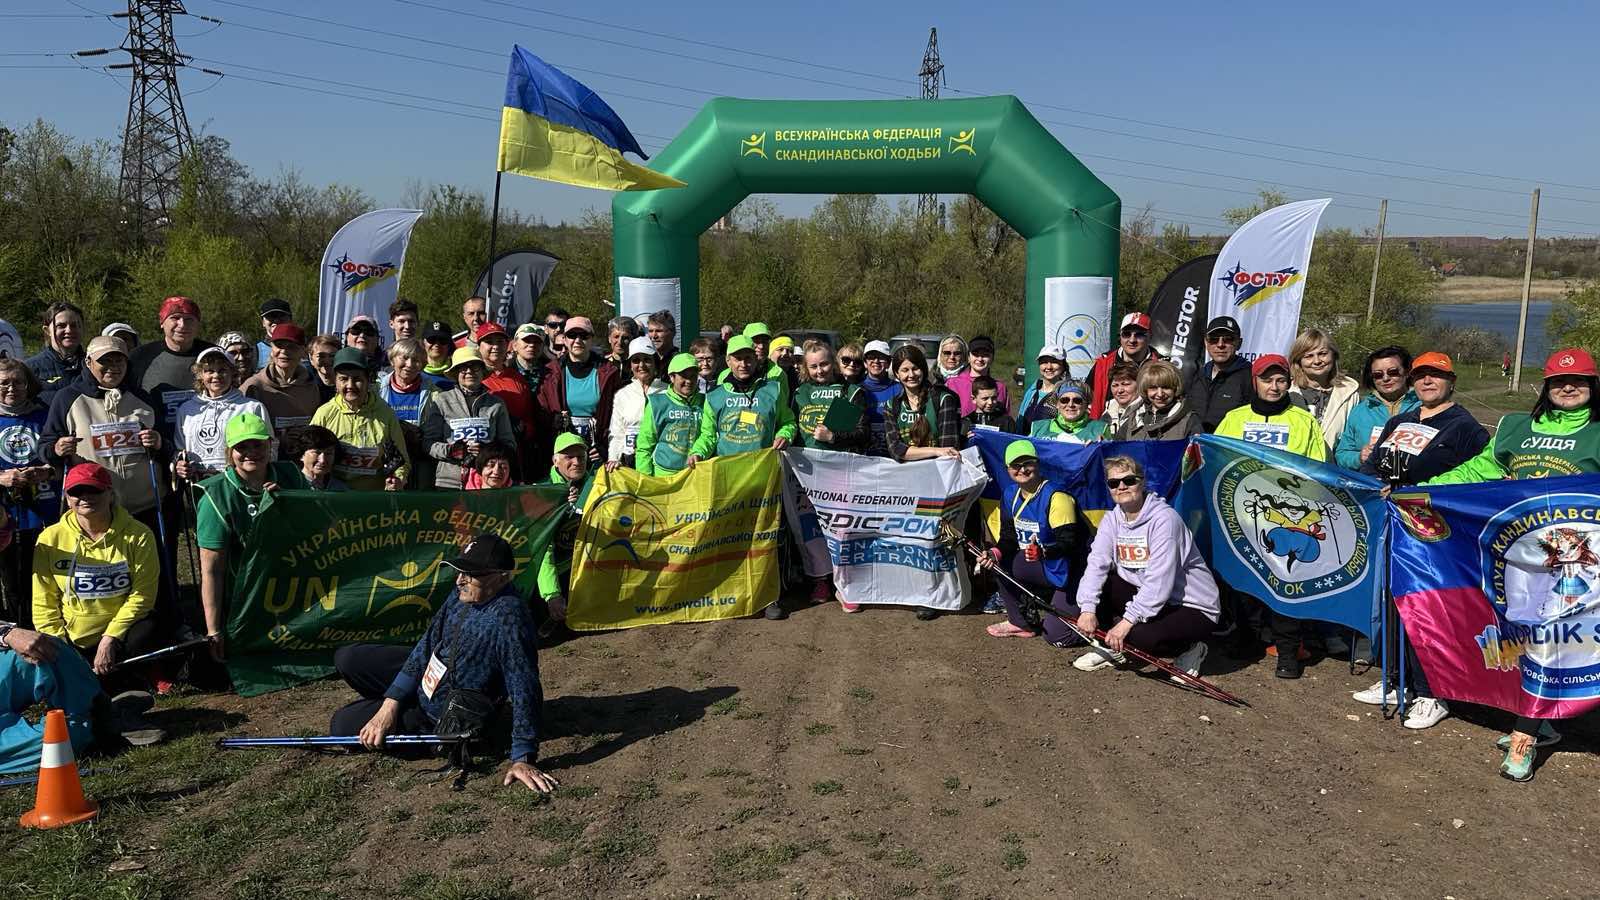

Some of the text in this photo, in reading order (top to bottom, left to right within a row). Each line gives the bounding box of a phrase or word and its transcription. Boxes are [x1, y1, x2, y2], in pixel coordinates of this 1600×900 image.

[775, 127, 942, 142] ВСЕУКРАЇНСЬКА ФЕДЕРАЦІЯ
[775, 146, 941, 163] СКАНДИНАВСЬКОЇ ХОДЬБИ
[1233, 271, 1293, 287] ФСТУ
[1170, 286, 1200, 370] OTECTOR
[811, 389, 841, 399] СУДДЯ
[97, 432, 141, 449] 124
[453, 427, 489, 441] 525
[1244, 431, 1285, 444] 521
[1520, 436, 1577, 450] СУДДЯ
[802, 487, 916, 507] NATIONAL FEDERATION
[281, 509, 421, 568] УКРАЇНСЬКА
[314, 530, 478, 571] UKRAINIAN FEDERA
[77, 574, 131, 592] 526
[1494, 560, 1506, 605] КЛУБ
[263, 575, 340, 615] UN
[634, 596, 737, 614] www.nwalk.ua
[318, 627, 385, 642] NORDIC
